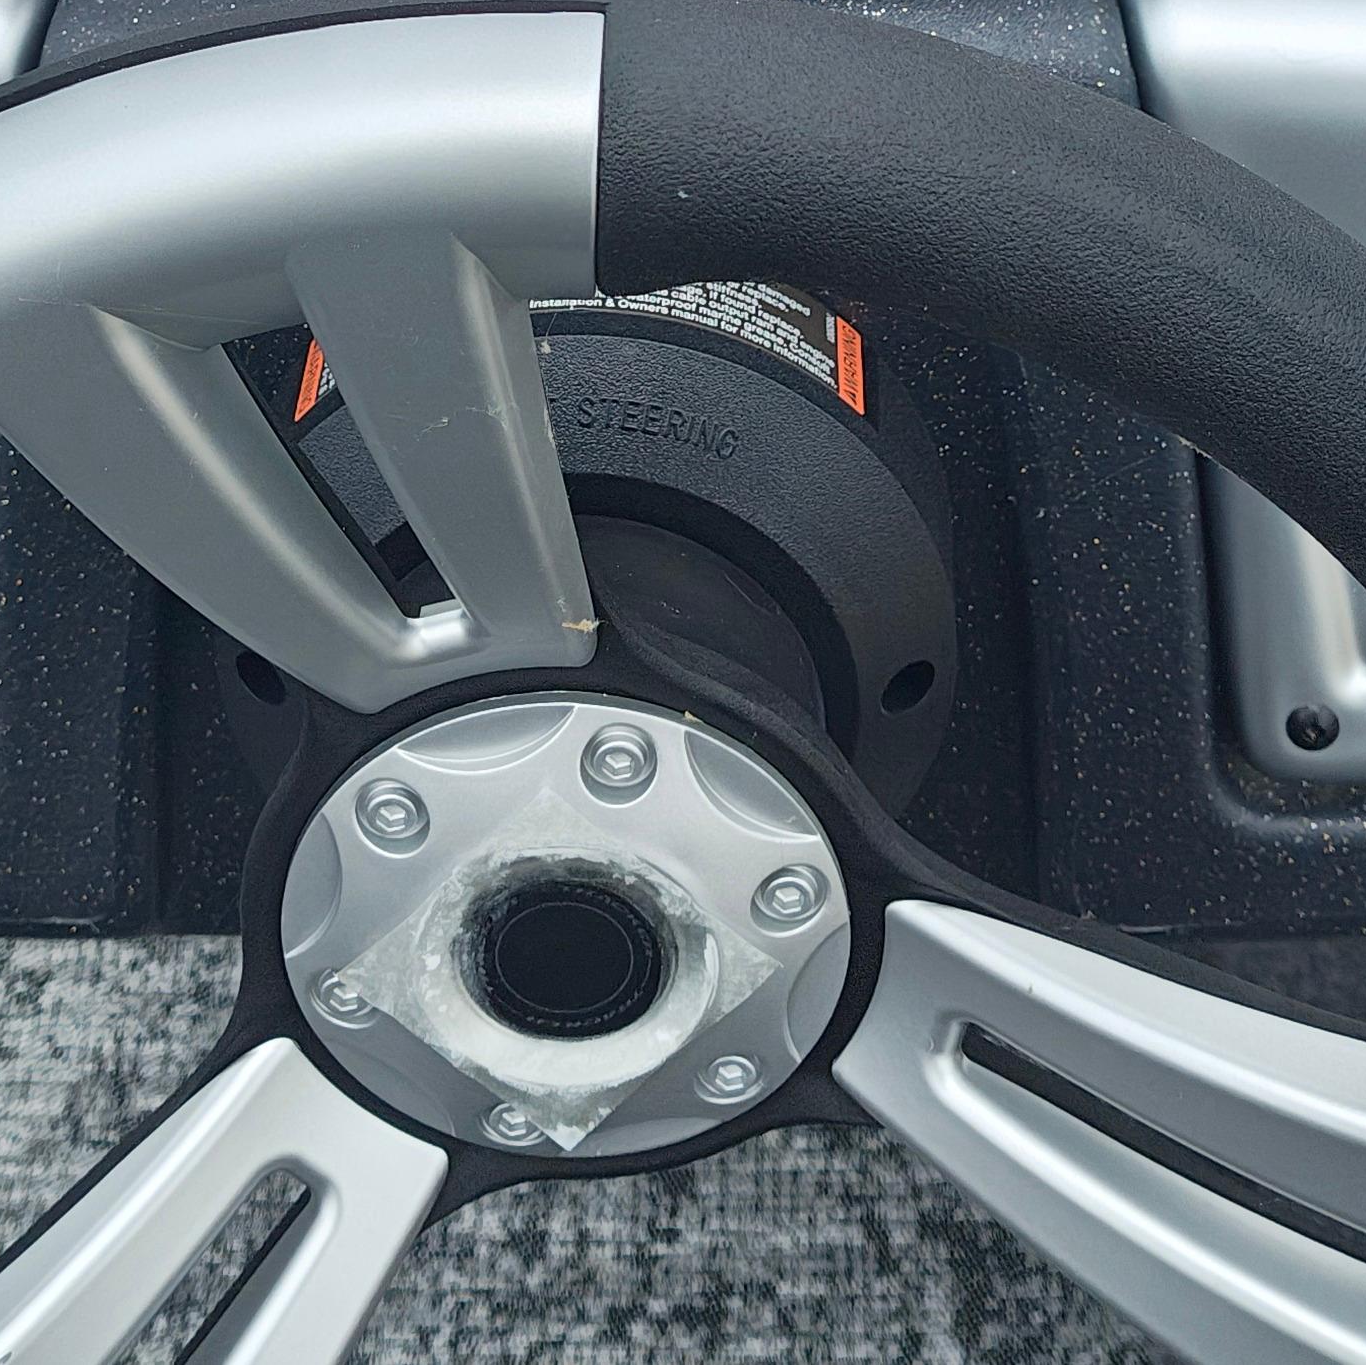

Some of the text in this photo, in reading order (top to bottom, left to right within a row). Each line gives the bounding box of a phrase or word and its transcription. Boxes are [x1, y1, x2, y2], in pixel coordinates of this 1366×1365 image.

[670, 308, 719, 327] manual
[720, 320, 739, 335] for
[739, 329, 772, 349] more
[698, 306, 743, 327] marine
[577, 396, 740, 462] STEERING
